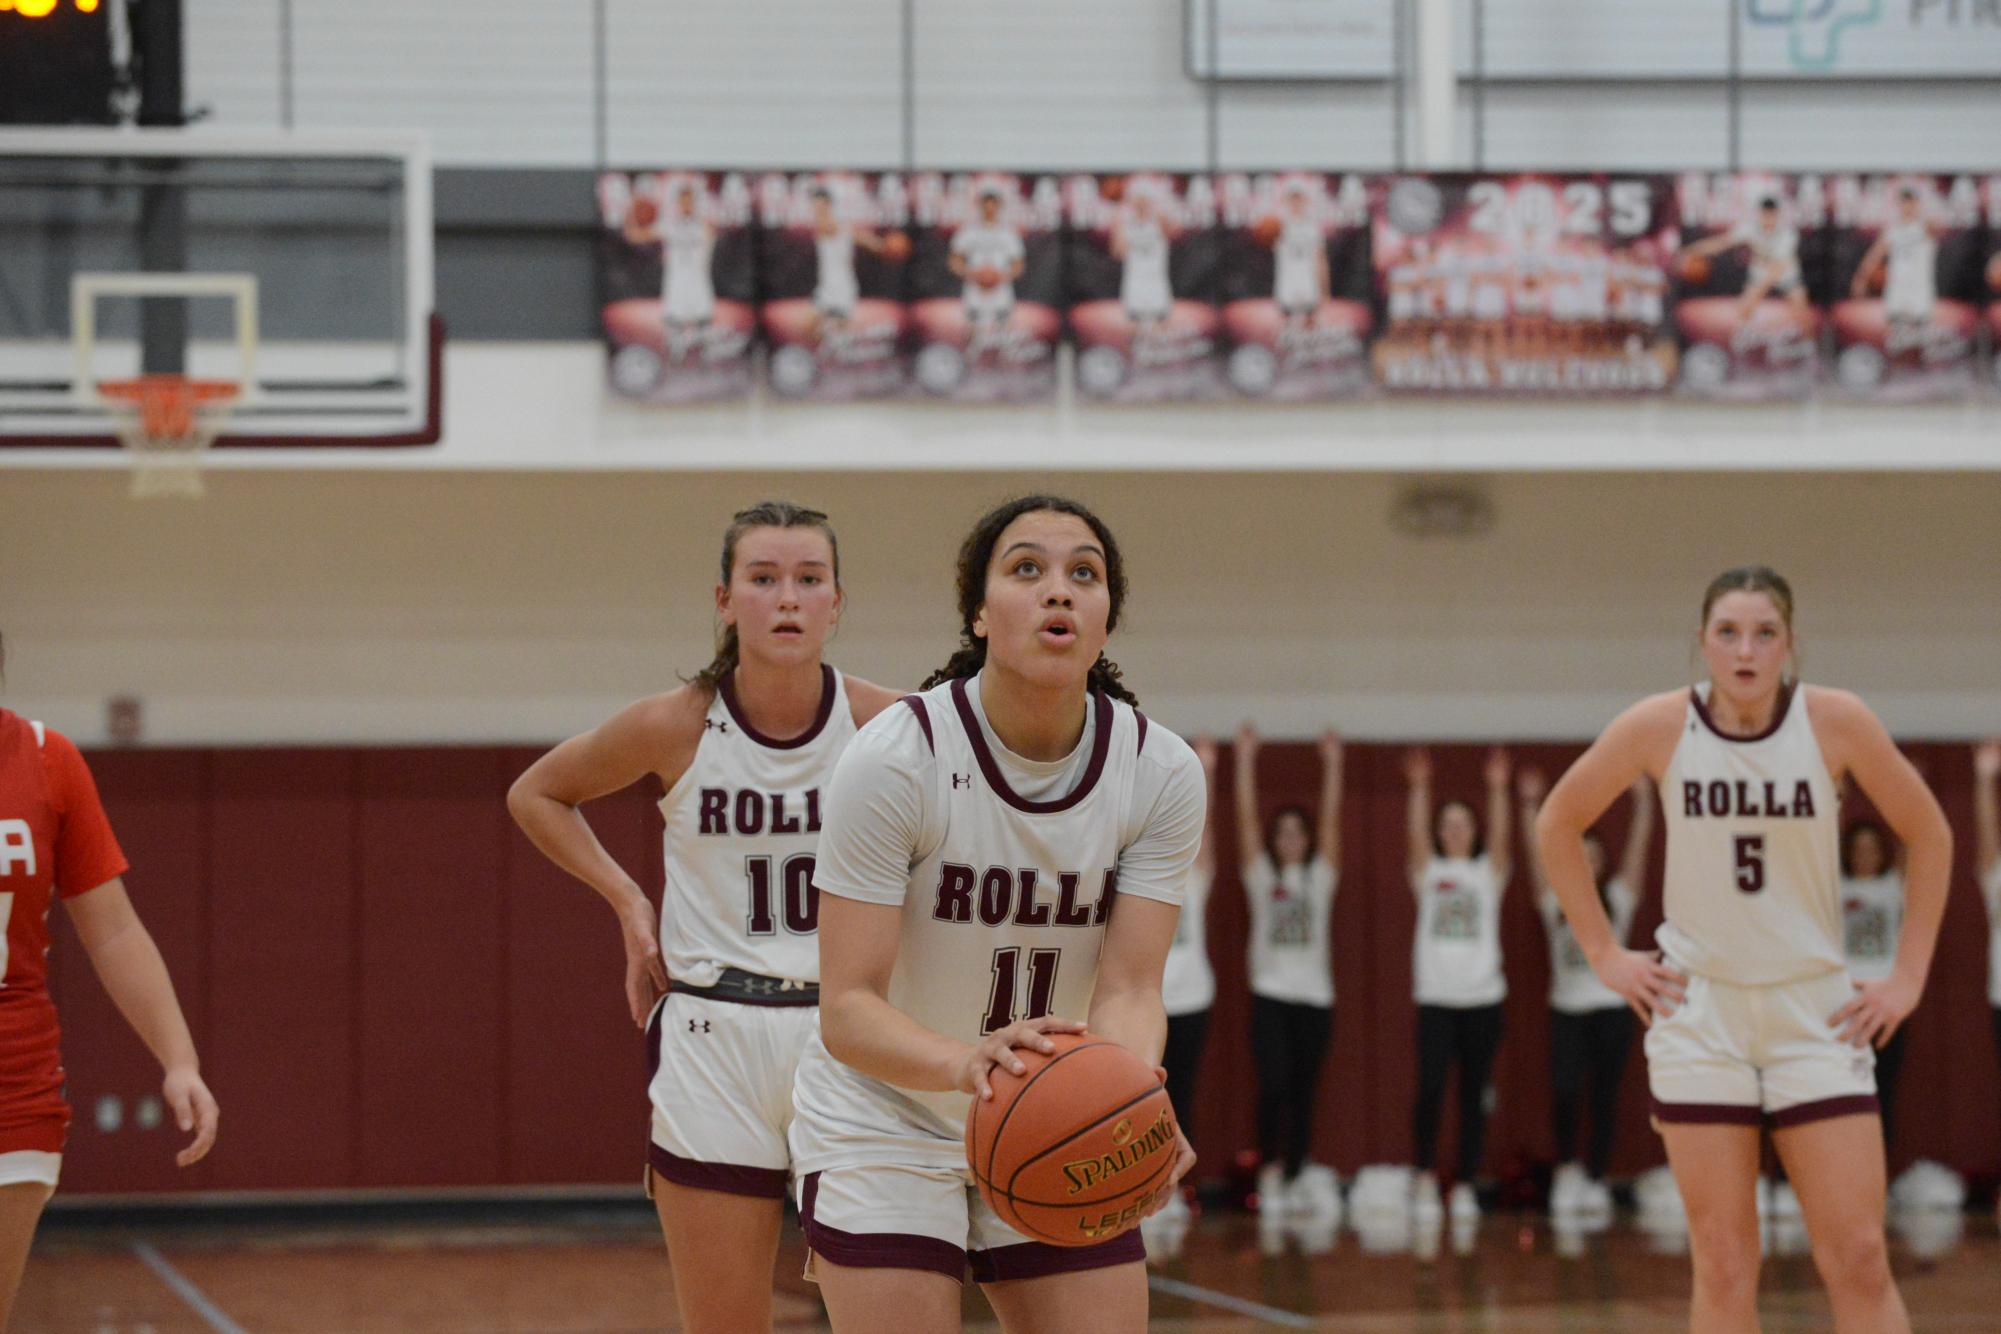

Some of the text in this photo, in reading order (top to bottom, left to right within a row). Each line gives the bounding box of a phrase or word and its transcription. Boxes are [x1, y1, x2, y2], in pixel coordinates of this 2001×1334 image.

[1466, 181, 1650, 235] 2025
[1683, 779, 1816, 818] ROLLA
[745, 852, 820, 936] 10
[1733, 834, 1766, 894] 5
[980, 947, 1061, 1036] 11
[1062, 1108, 1174, 1195] SPALDING
